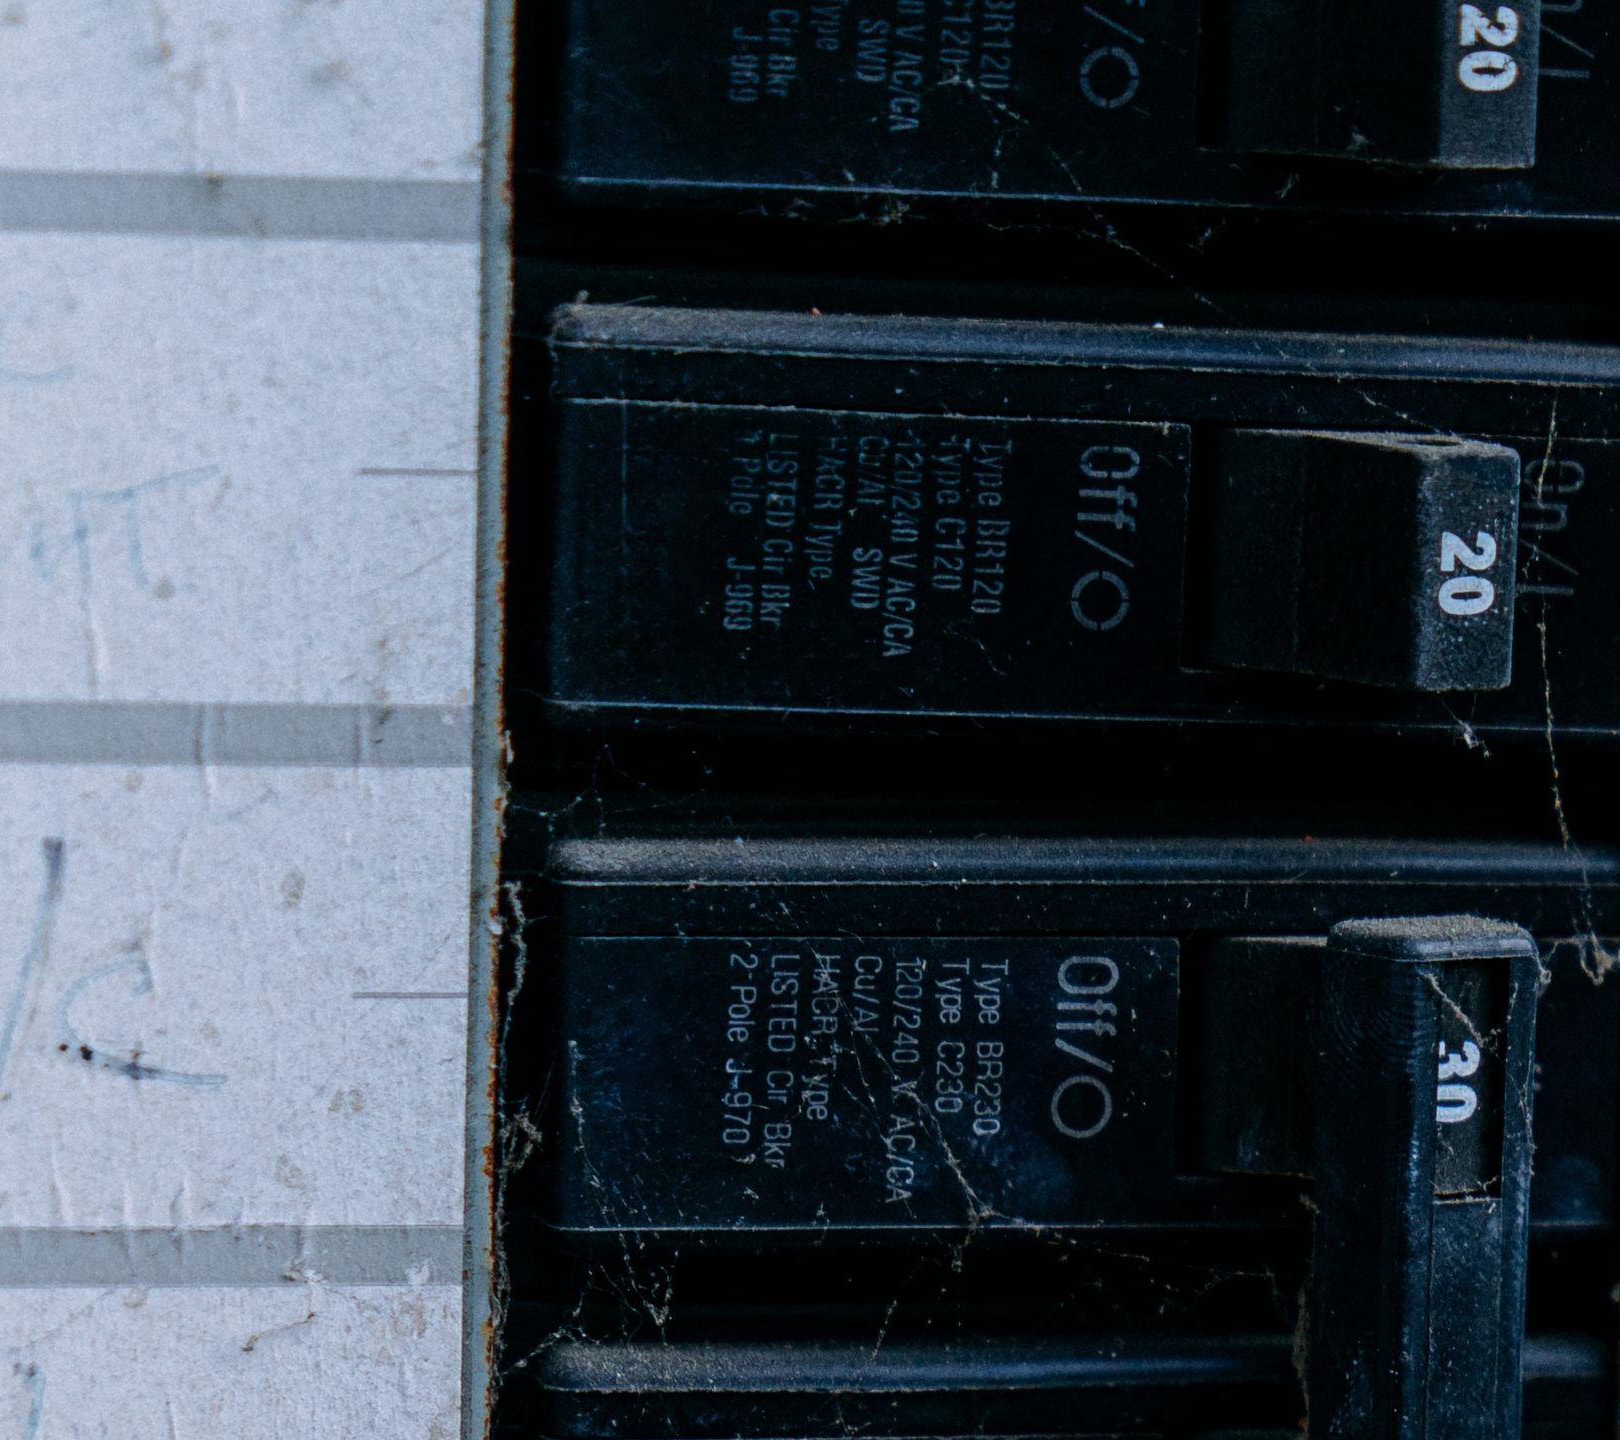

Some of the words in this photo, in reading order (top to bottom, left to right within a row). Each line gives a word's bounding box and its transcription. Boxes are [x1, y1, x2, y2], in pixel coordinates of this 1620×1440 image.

[854, 17, 891, 82] SWD
[1456, 4, 1522, 93] 20
[727, 456, 762, 515] Pole
[764, 432, 799, 528] LISTED
[813, 434, 849, 512] HACR
[888, 432, 924, 543] 120/240
[935, 433, 971, 506] Type
[976, 438, 1012, 507] Type
[761, 537, 795, 575] Cir
[805, 520, 844, 581] Type
[849, 546, 883, 610] SWD
[890, 552, 919, 568] V
[931, 517, 966, 592] C120
[970, 518, 1010, 615] BR120
[1437, 530, 1499, 617] 20
[722, 556, 756, 633] J-969
[758, 583, 792, 628] Bkr
[880, 579, 915, 658] AC/CA
[725, 985, 757, 1043] Pole
[766, 953, 800, 1054] LISTED
[811, 953, 840, 1036] HACR
[852, 953, 883, 1034] Cu/Al
[891, 957, 926, 1065] 120/240
[934, 957, 970, 1025] Type
[974, 958, 1009, 1026] Type
[720, 1058, 752, 1145] J-970
[765, 1069, 797, 1104] Cir
[799, 1056, 838, 1121] Type
[933, 1039, 966, 1115] C230
[972, 1040, 1004, 1136] BR230
[1430, 1040, 1478, 1129] 30
[762, 1121, 793, 1169] Bkr
[884, 1113, 915, 1204] AC/CA
